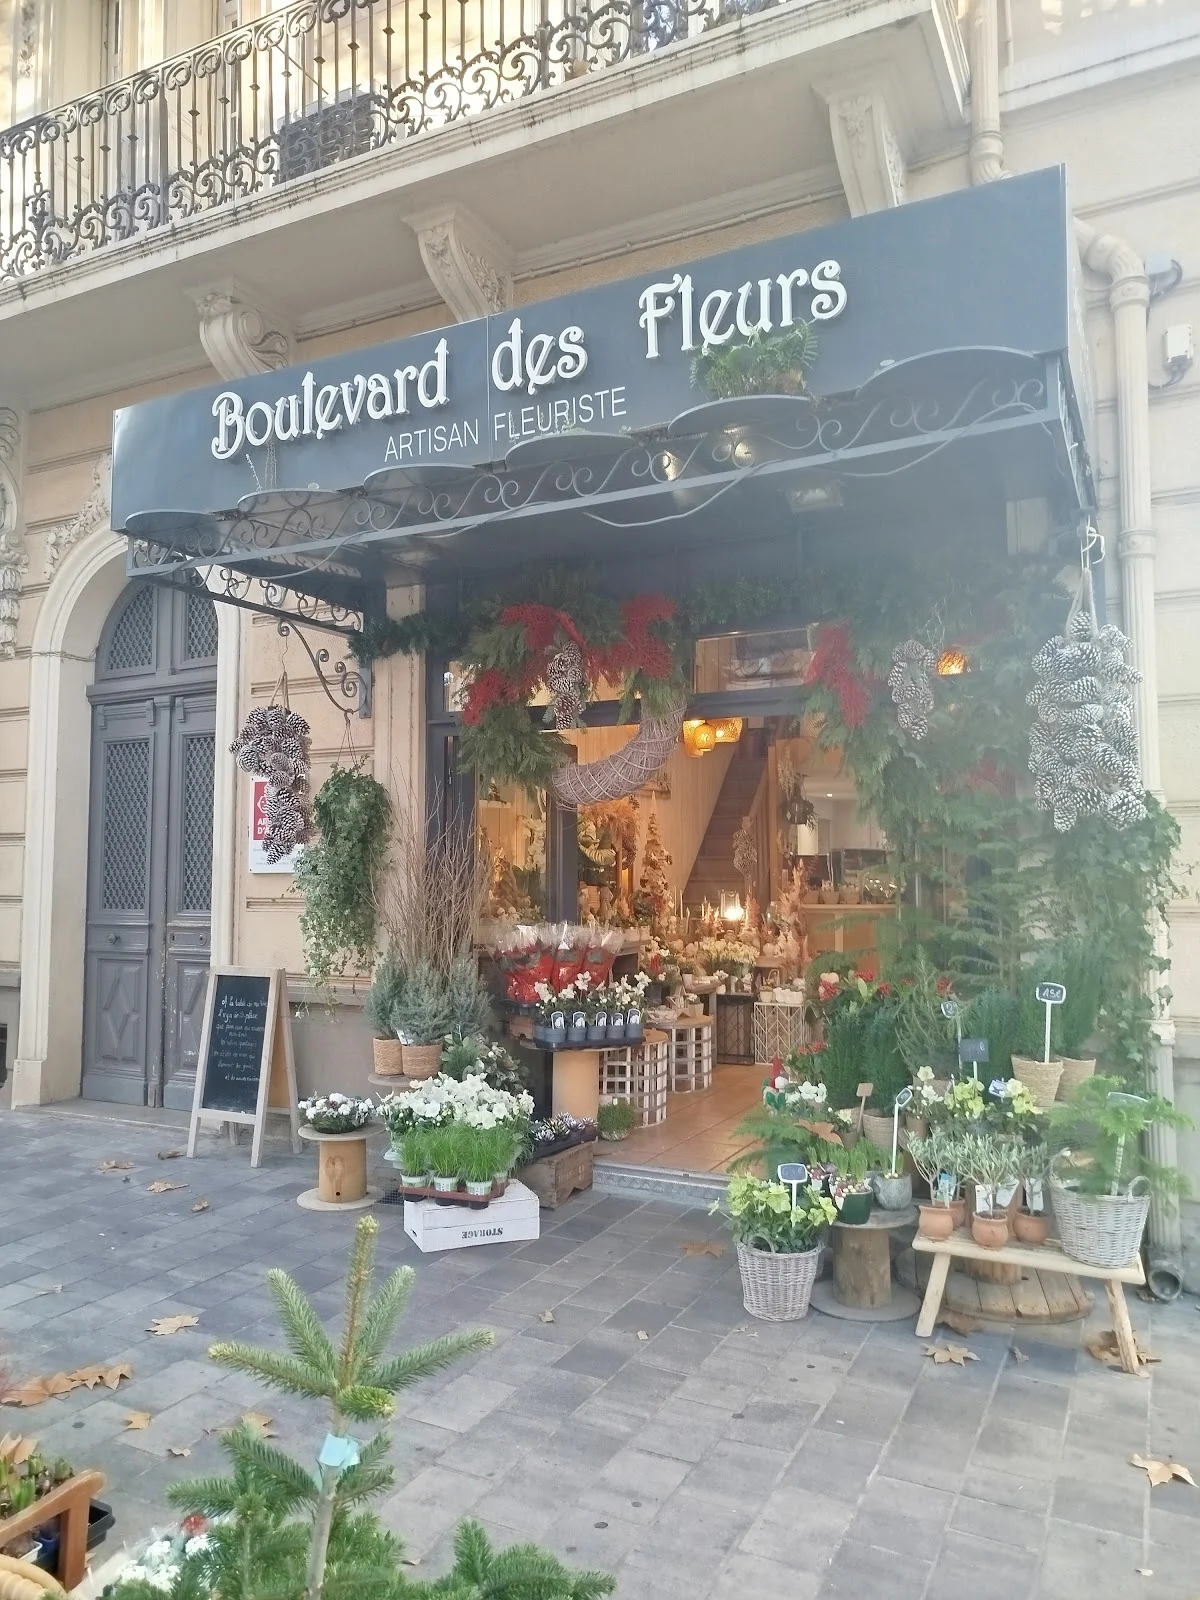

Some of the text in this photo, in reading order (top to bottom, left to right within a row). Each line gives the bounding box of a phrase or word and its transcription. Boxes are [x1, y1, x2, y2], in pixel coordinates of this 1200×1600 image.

[211, 259, 848, 460] Boulevard des Fleurs
[384, 386, 627, 462] ARTISAN FLEURISTE
[462, 1227, 503, 1240] STORAGE
